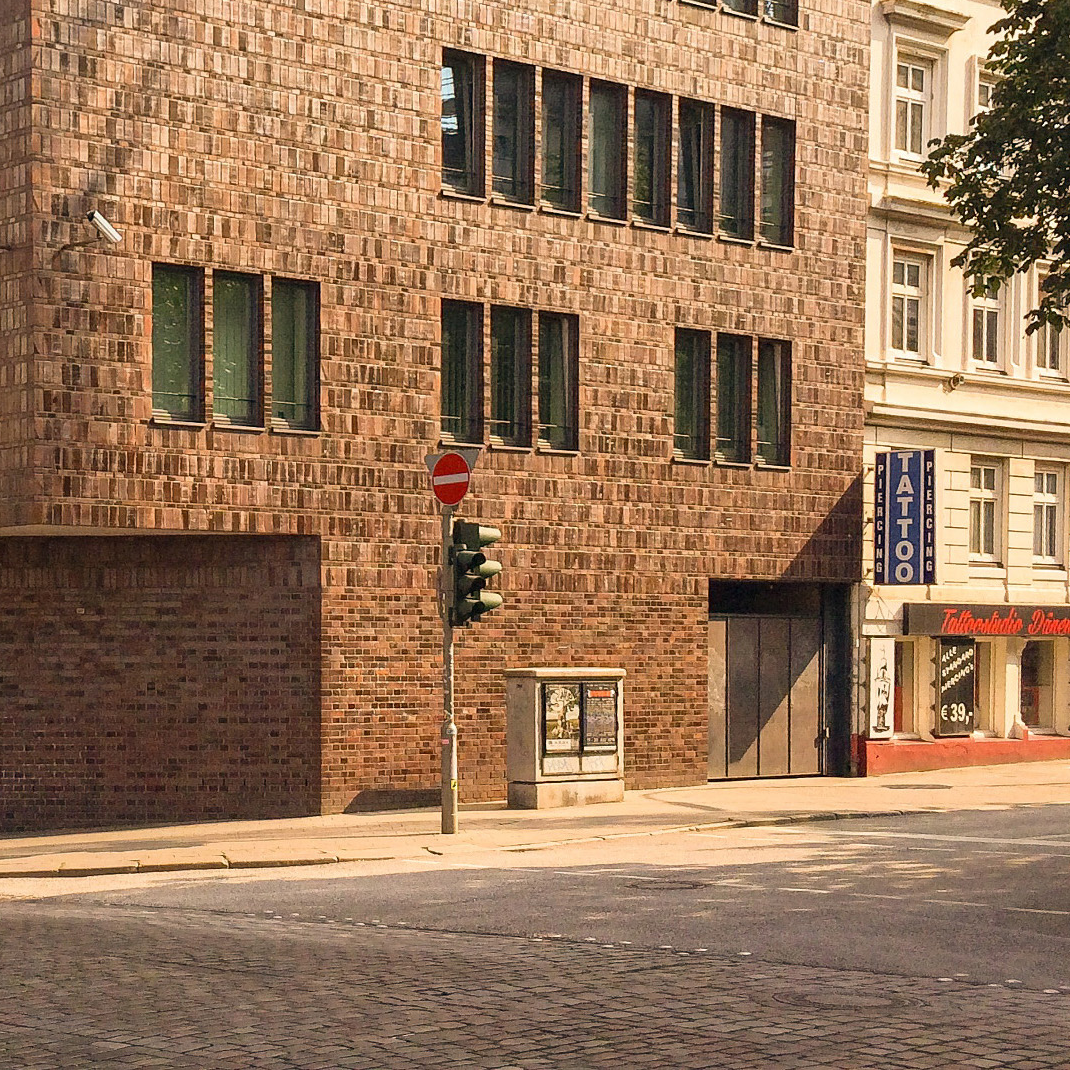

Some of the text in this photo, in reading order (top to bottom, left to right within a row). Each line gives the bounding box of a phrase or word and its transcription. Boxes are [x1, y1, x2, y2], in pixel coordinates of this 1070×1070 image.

[876, 464, 884, 573] PIERCING
[895, 452, 914, 583] TATTOO
[941, 607, 1023, 634] Tattoostudio
[942, 646, 957, 662] ALLE
[942, 648, 973, 677] STANDARD
